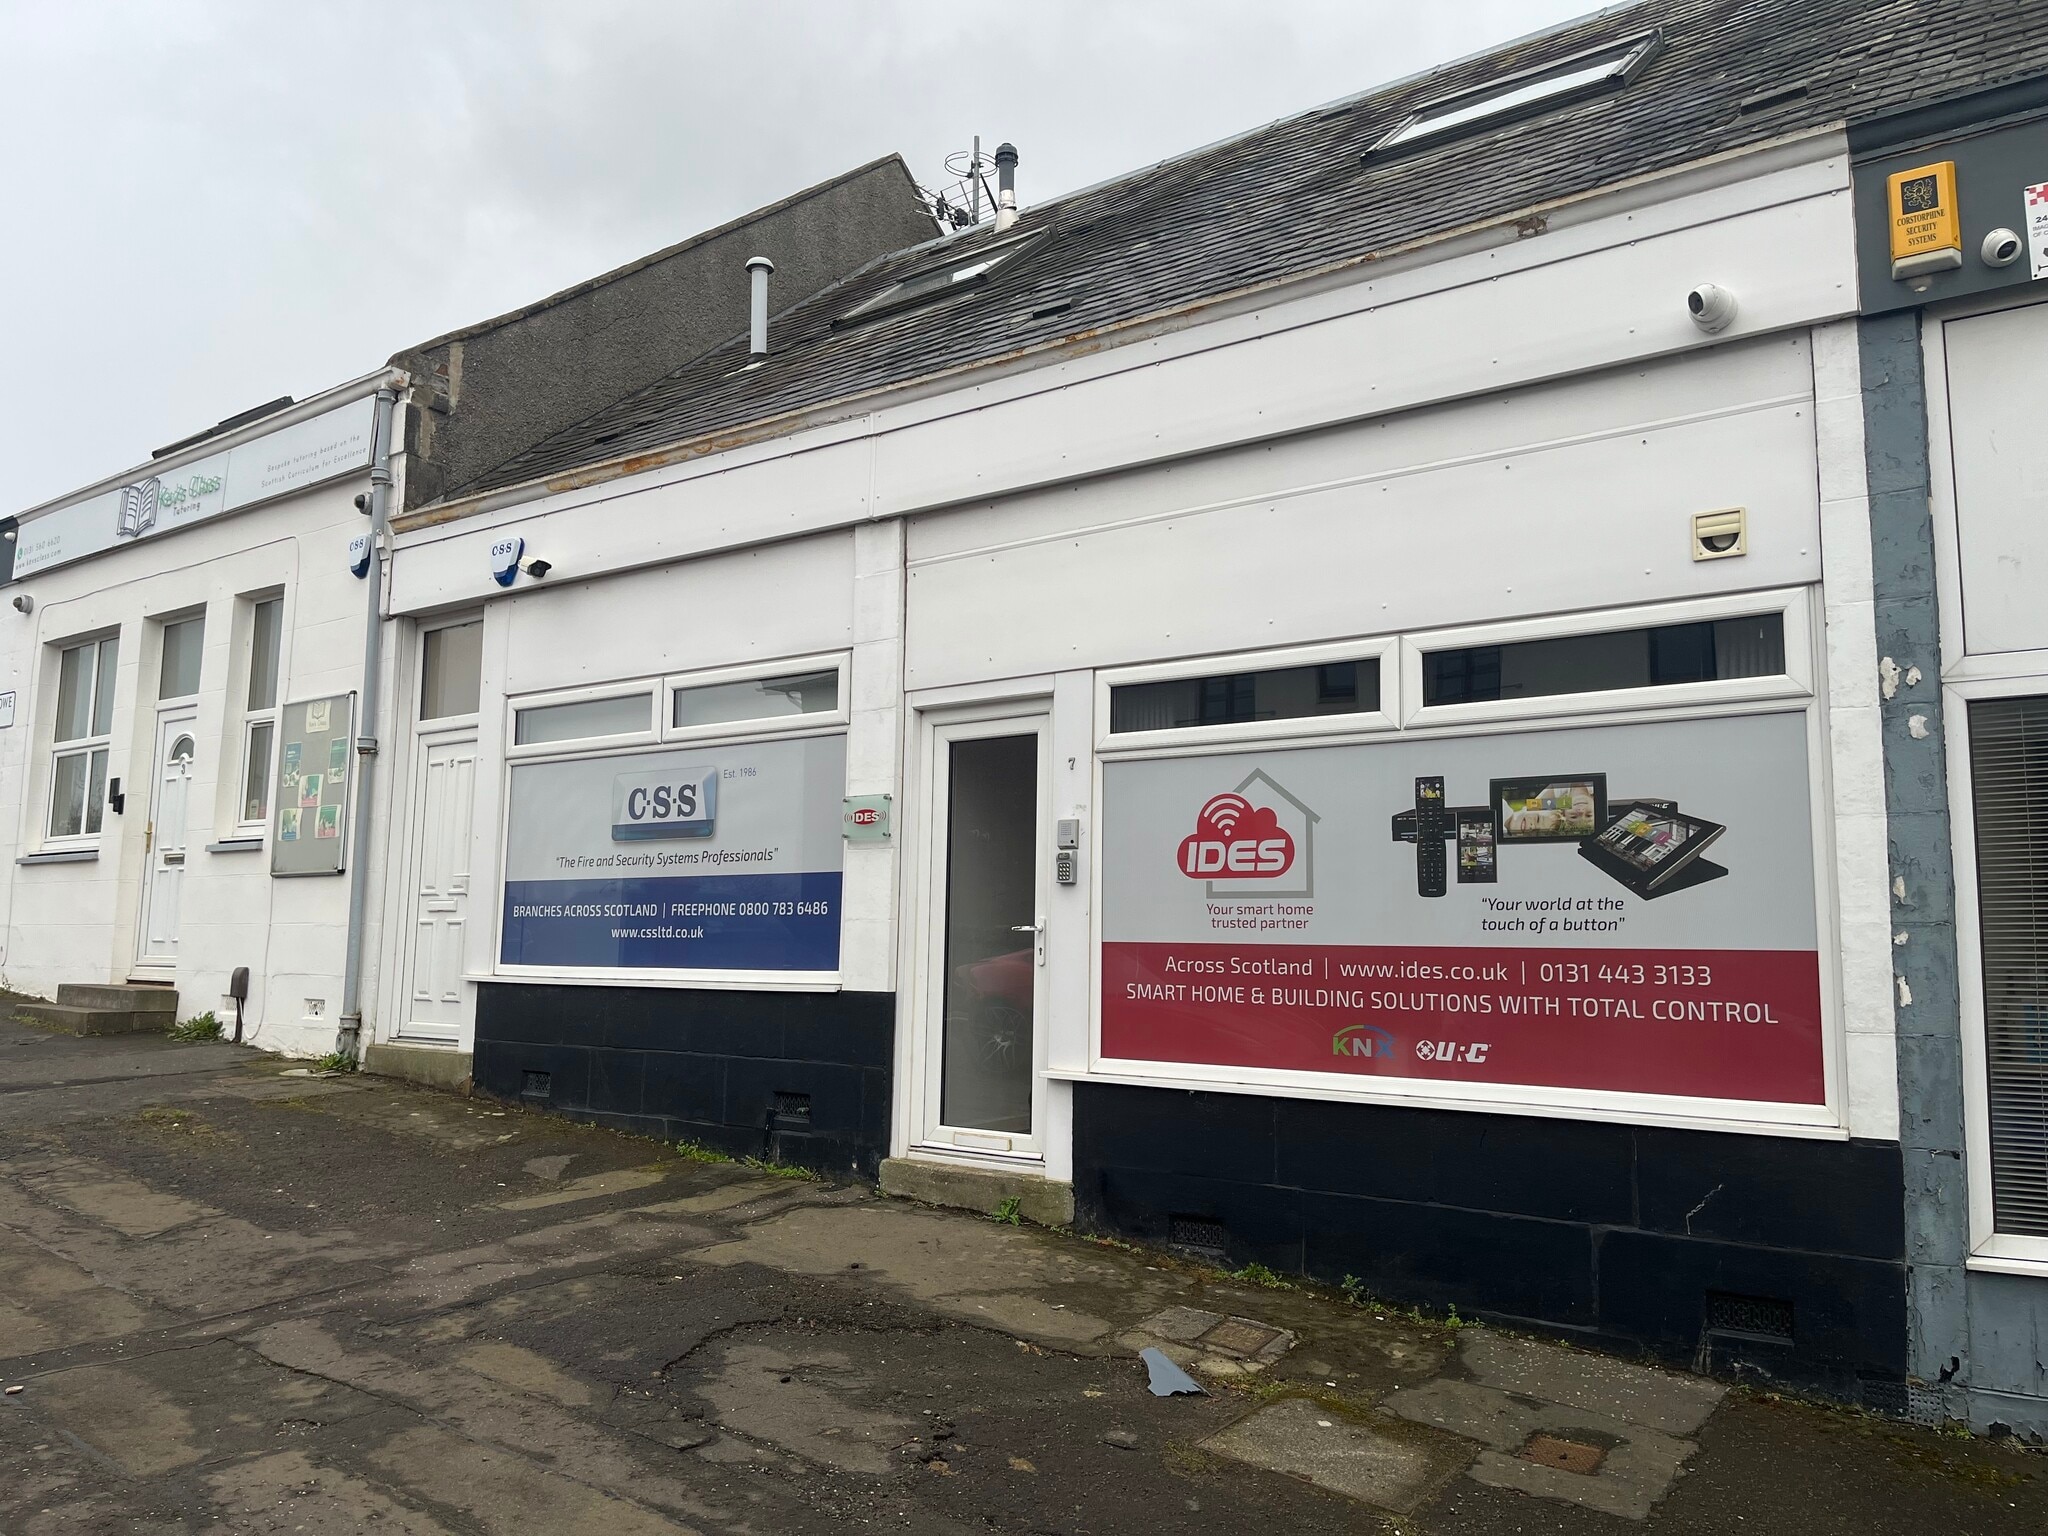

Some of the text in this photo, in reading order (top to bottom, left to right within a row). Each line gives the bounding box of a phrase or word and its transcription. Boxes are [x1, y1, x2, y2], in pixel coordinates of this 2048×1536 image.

[1897, 208, 1945, 226] CORSTORPHINE
[1906, 222, 1937, 236] SECURITY
[1908, 233, 1937, 246] SYSTEMS
[294, 450, 317, 464] tutoring
[320, 442, 337, 454] based
[350, 435, 360, 443] the
[181, 764, 186, 774] 3
[450, 758, 455, 768] 5
[1068, 757, 1076, 770] 7
[723, 767, 757, 778] Est. 1986
[577, 855, 595, 868] Fire
[597, 854, 614, 866] and
[616, 851, 655, 866] Security
[657, 850, 699, 866] Systems
[1186, 839, 1286, 873] IDES
[513, 905, 562, 918] BRANCHES
[564, 905, 602, 918] ACROSS
[604, 903, 657, 918] SCOTLAND
[671, 902, 736, 917] FREEPHONE
[739, 902, 769, 916] 0800
[772, 901, 794, 916] 783
[797, 901, 828, 916] 6486
[1206, 903, 1314, 916] Your smart home
[1525, 897, 1572, 911] world
[1576, 900, 1593, 911] at
[1597, 898, 1624, 911] the
[1211, 917, 1309, 931] trusted partner
[1481, 918, 1525, 931] touch
[1529, 917, 1545, 934] of
[1549, 921, 1559, 931] a
[611, 926, 704, 939] www.cssltd.co.uk
[1165, 955, 1225, 973] Across
[1230, 957, 1313, 976] Scotland
[1340, 961, 1508, 982] www.ides.co.uk
[1540, 963, 1591, 983] 0131
[1598, 964, 1645, 985] 443
[1653, 965, 1712, 986] 3133
[1126, 982, 1779, 1024] SMART HOME & BUILDING SOLUTIONS WITH TOTAL CONTROL
[1332, 1036, 1396, 1059] KNX
